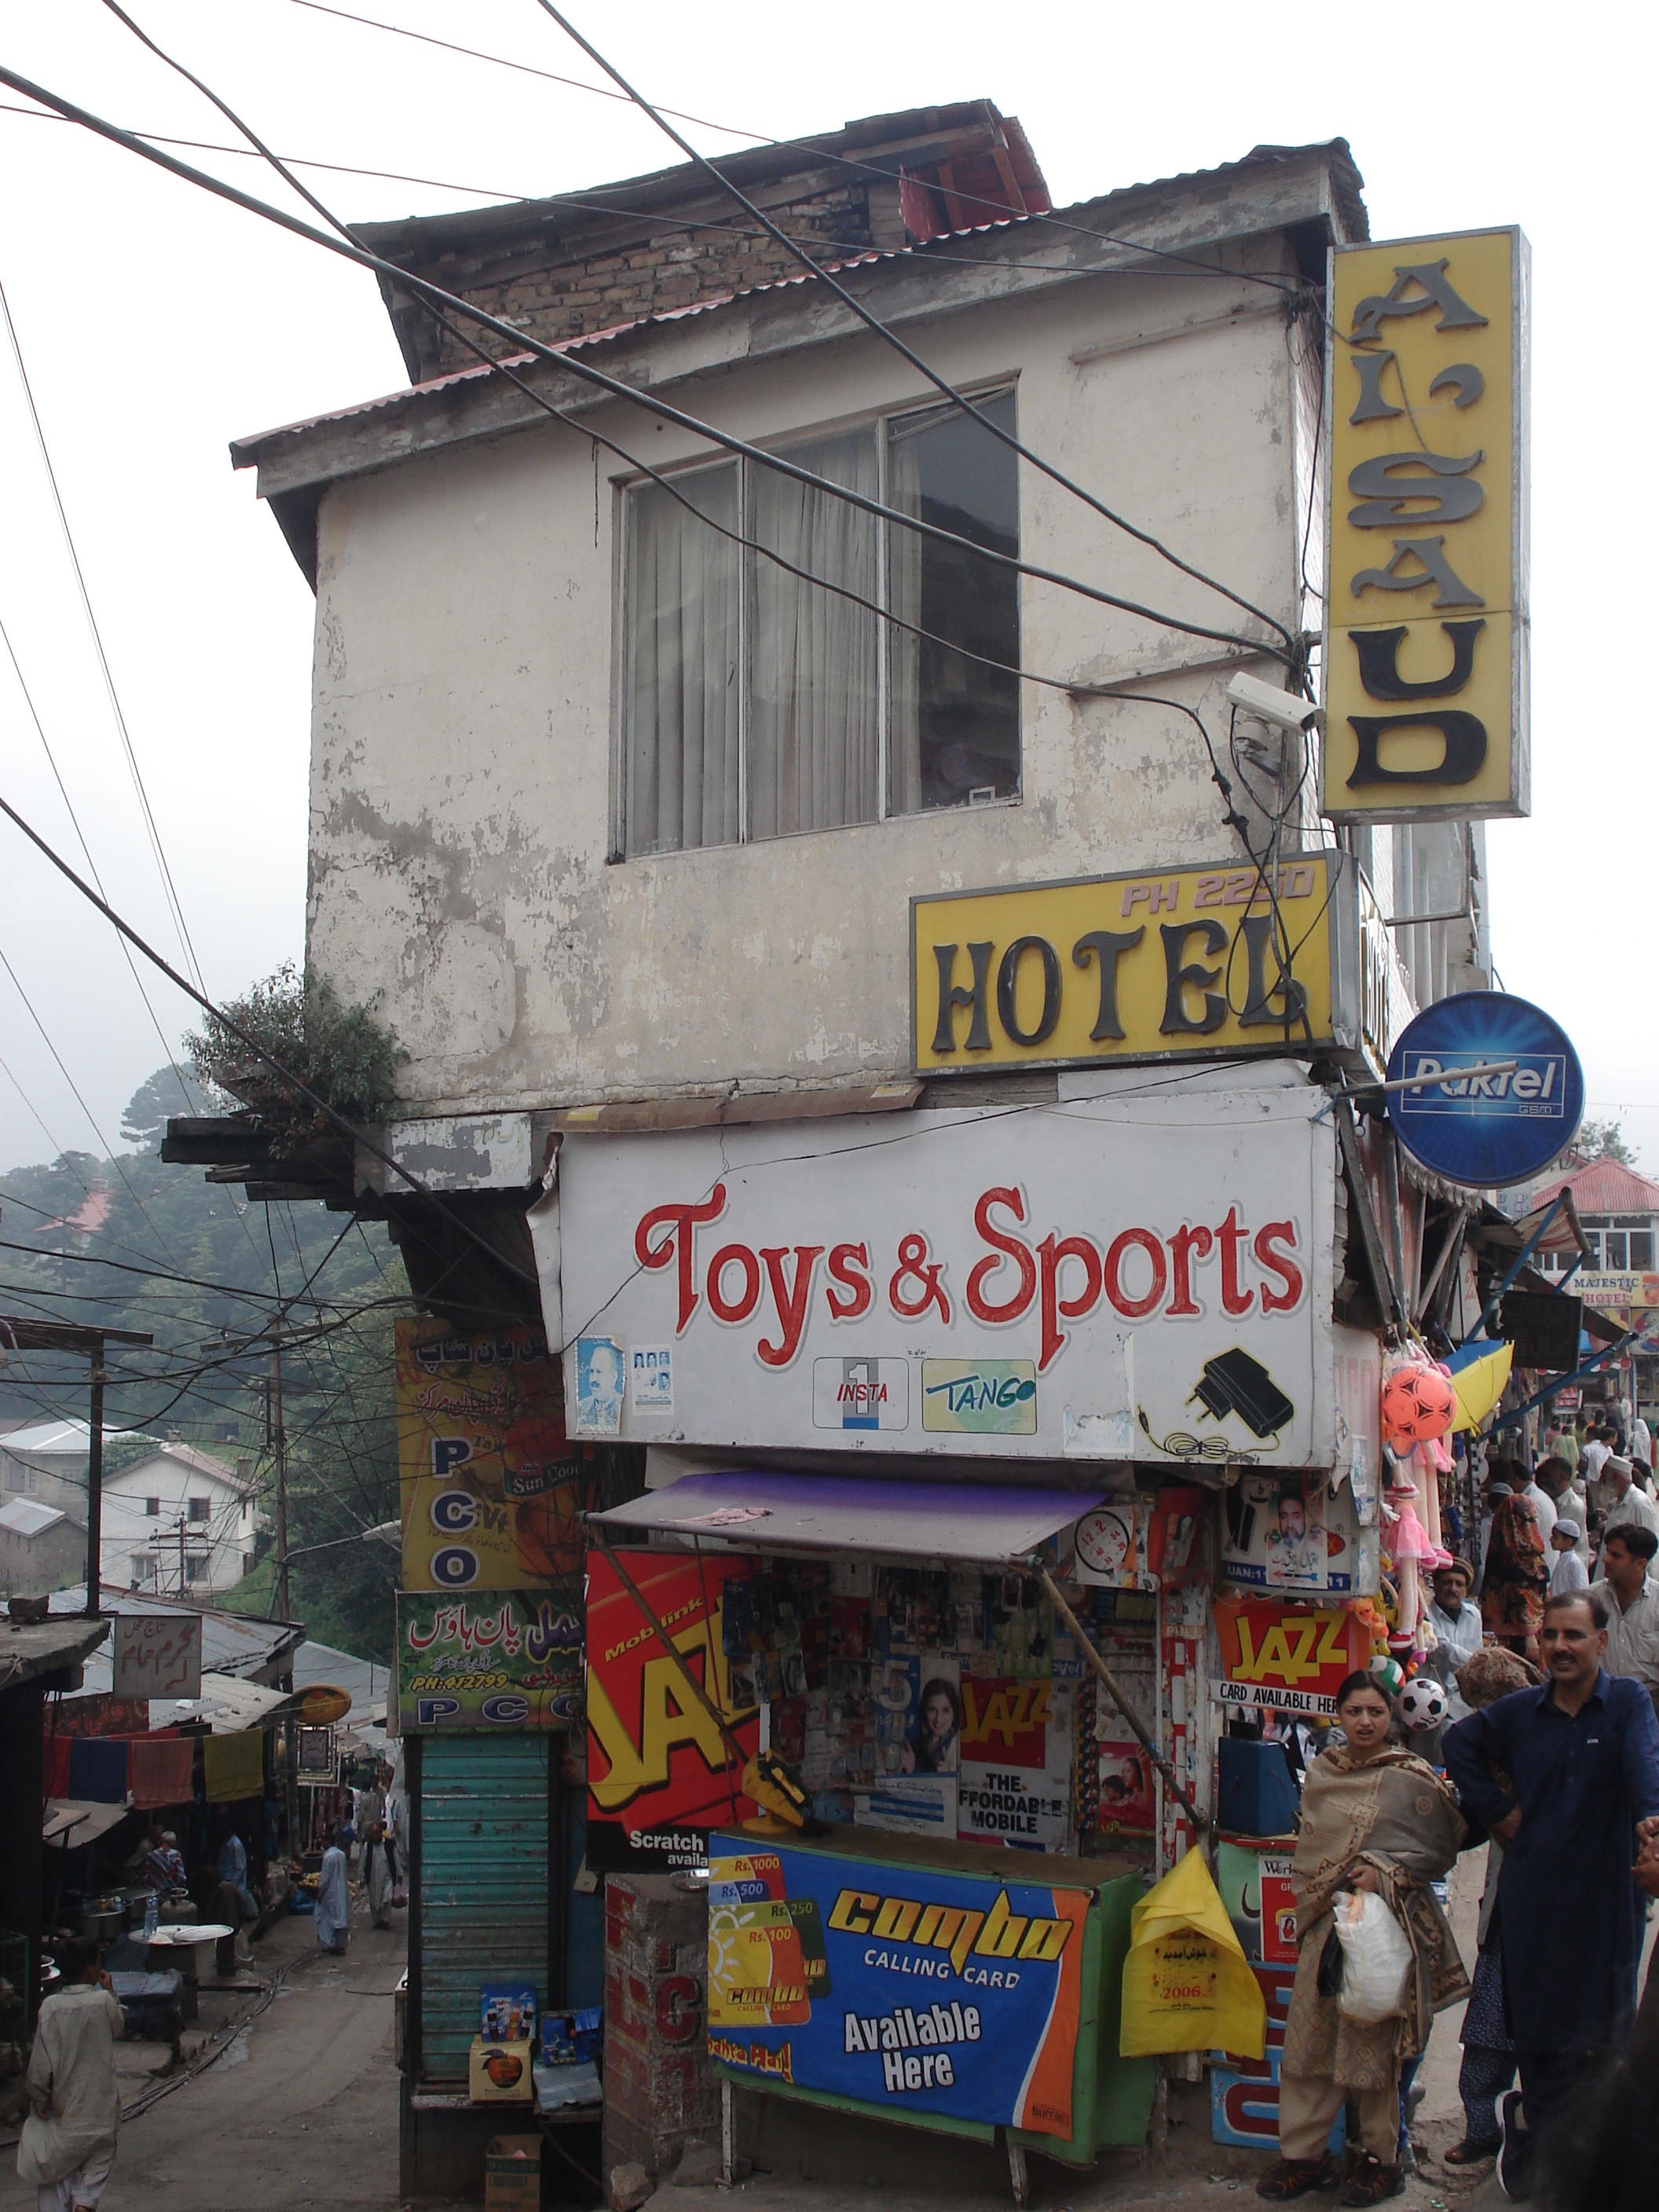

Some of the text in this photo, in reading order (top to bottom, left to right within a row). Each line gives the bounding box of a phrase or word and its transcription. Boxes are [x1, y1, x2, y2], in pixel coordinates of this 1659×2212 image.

[1121, 880, 1179, 917] PH
[931, 915, 1309, 1053] HOTEL
[1518, 1104, 1553, 1115] GSM
[634, 1182, 1305, 1371] Toys & Sports
[1573, 1277, 1639, 1303] MAJESTIC HOTEL
[837, 1383, 888, 1402] INSTA
[925, 1374, 1036, 1414] TANGO
[513, 1478, 544, 1494] Sun
[605, 1597, 704, 1663] Moblink
[1232, 1610, 1348, 1686] JAZZ
[1220, 1683, 1247, 1701] CARD
[1253, 1688, 1312, 1710] AVAILABLE
[959, 1679, 1053, 1747] JAZZ
[986, 1773, 1022, 1793] THE
[958, 1789, 1064, 1818] FFORDABLE
[971, 1811, 1038, 1835] MOBILE
[629, 1829, 705, 1852] Scratch
[668, 1852, 709, 1868] availa
[734, 1856, 780, 1873] Rs. 1000
[1264, 1859, 1293, 1875] Worl
[740, 1883, 764, 1897] 500
[790, 1901, 813, 1916] 250
[749, 1928, 792, 1944] Rs. 100
[828, 1888, 1075, 1977] combo
[863, 1948, 1020, 1990] CALLING CARD
[727, 1978, 805, 2013] combo
[1163, 1986, 1201, 2000] 2006
[843, 2001, 982, 2053] Available
[881, 2052, 955, 2093] Here
